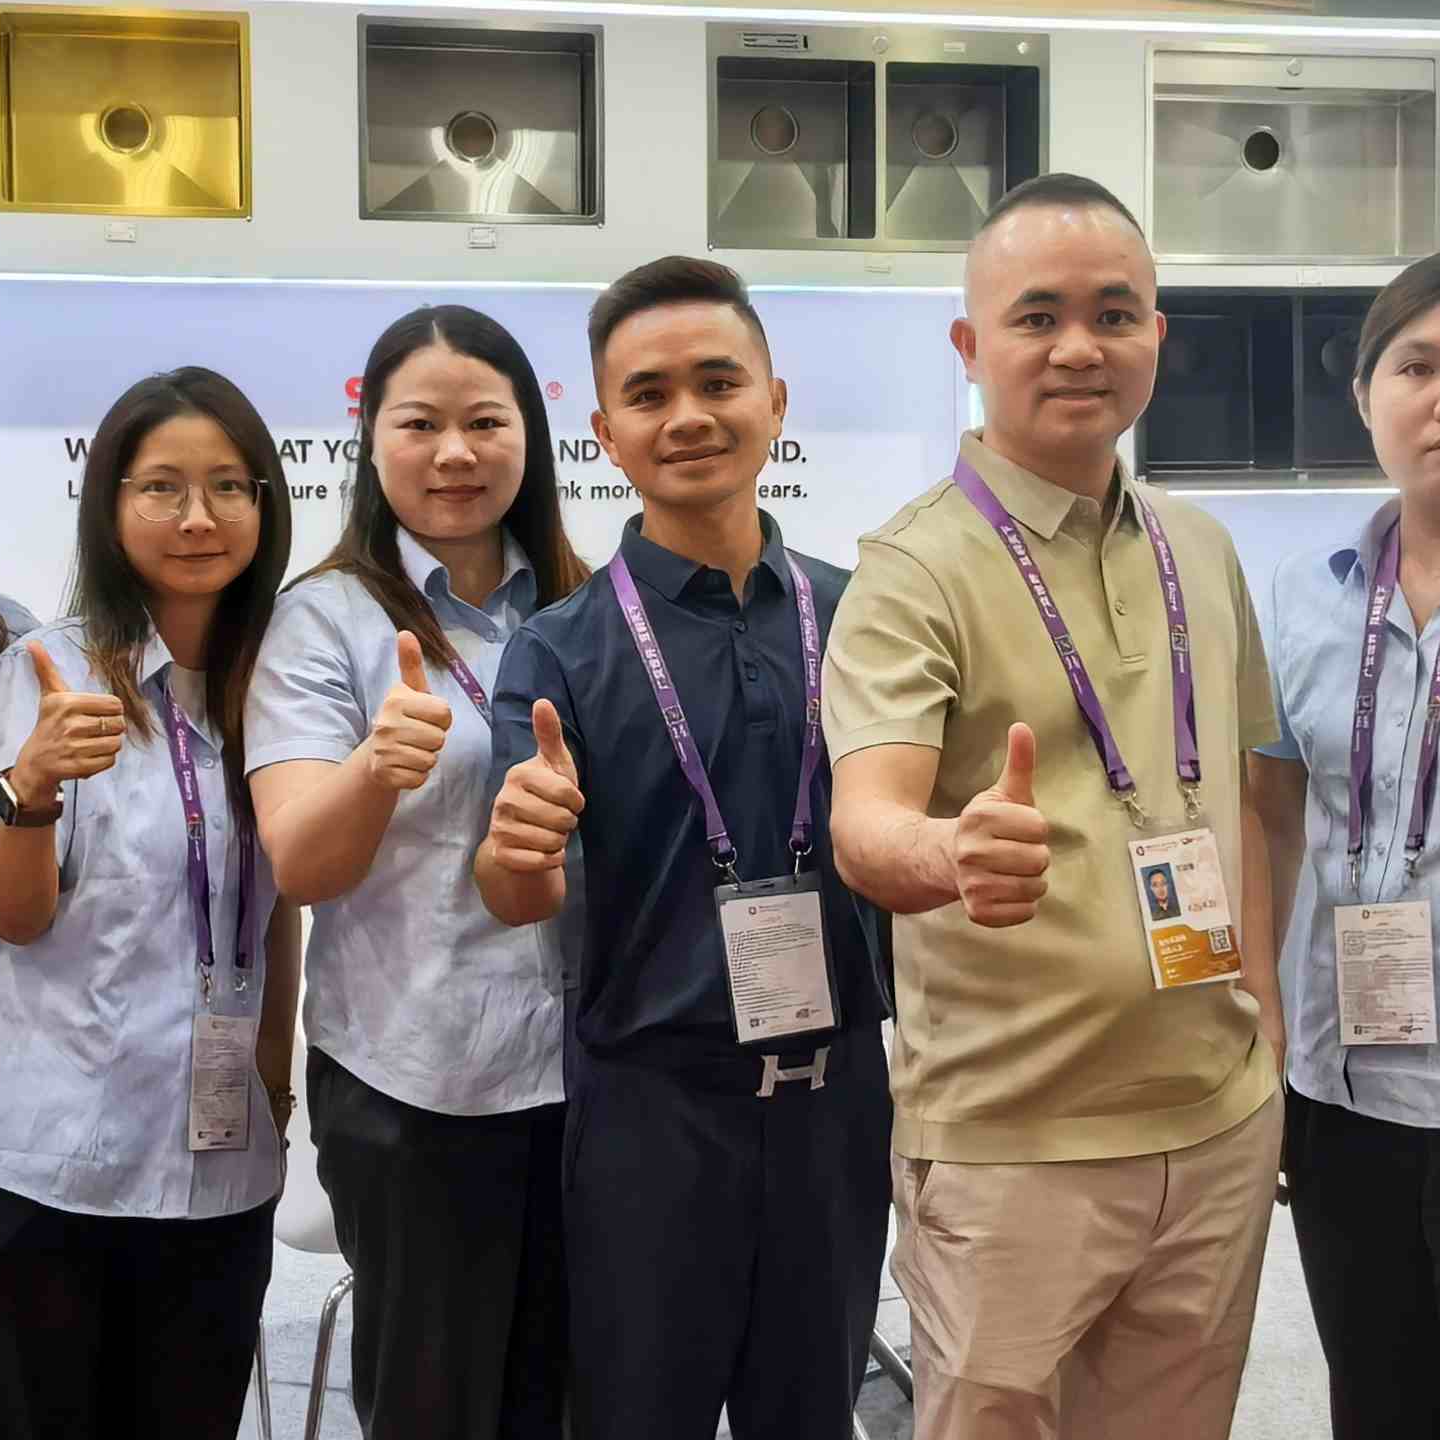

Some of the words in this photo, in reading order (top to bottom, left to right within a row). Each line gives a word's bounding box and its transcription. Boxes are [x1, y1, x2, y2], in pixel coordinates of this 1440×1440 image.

[323, 439, 363, 464] YO
[559, 440, 601, 462] ND
[758, 482, 808, 499] ears.
